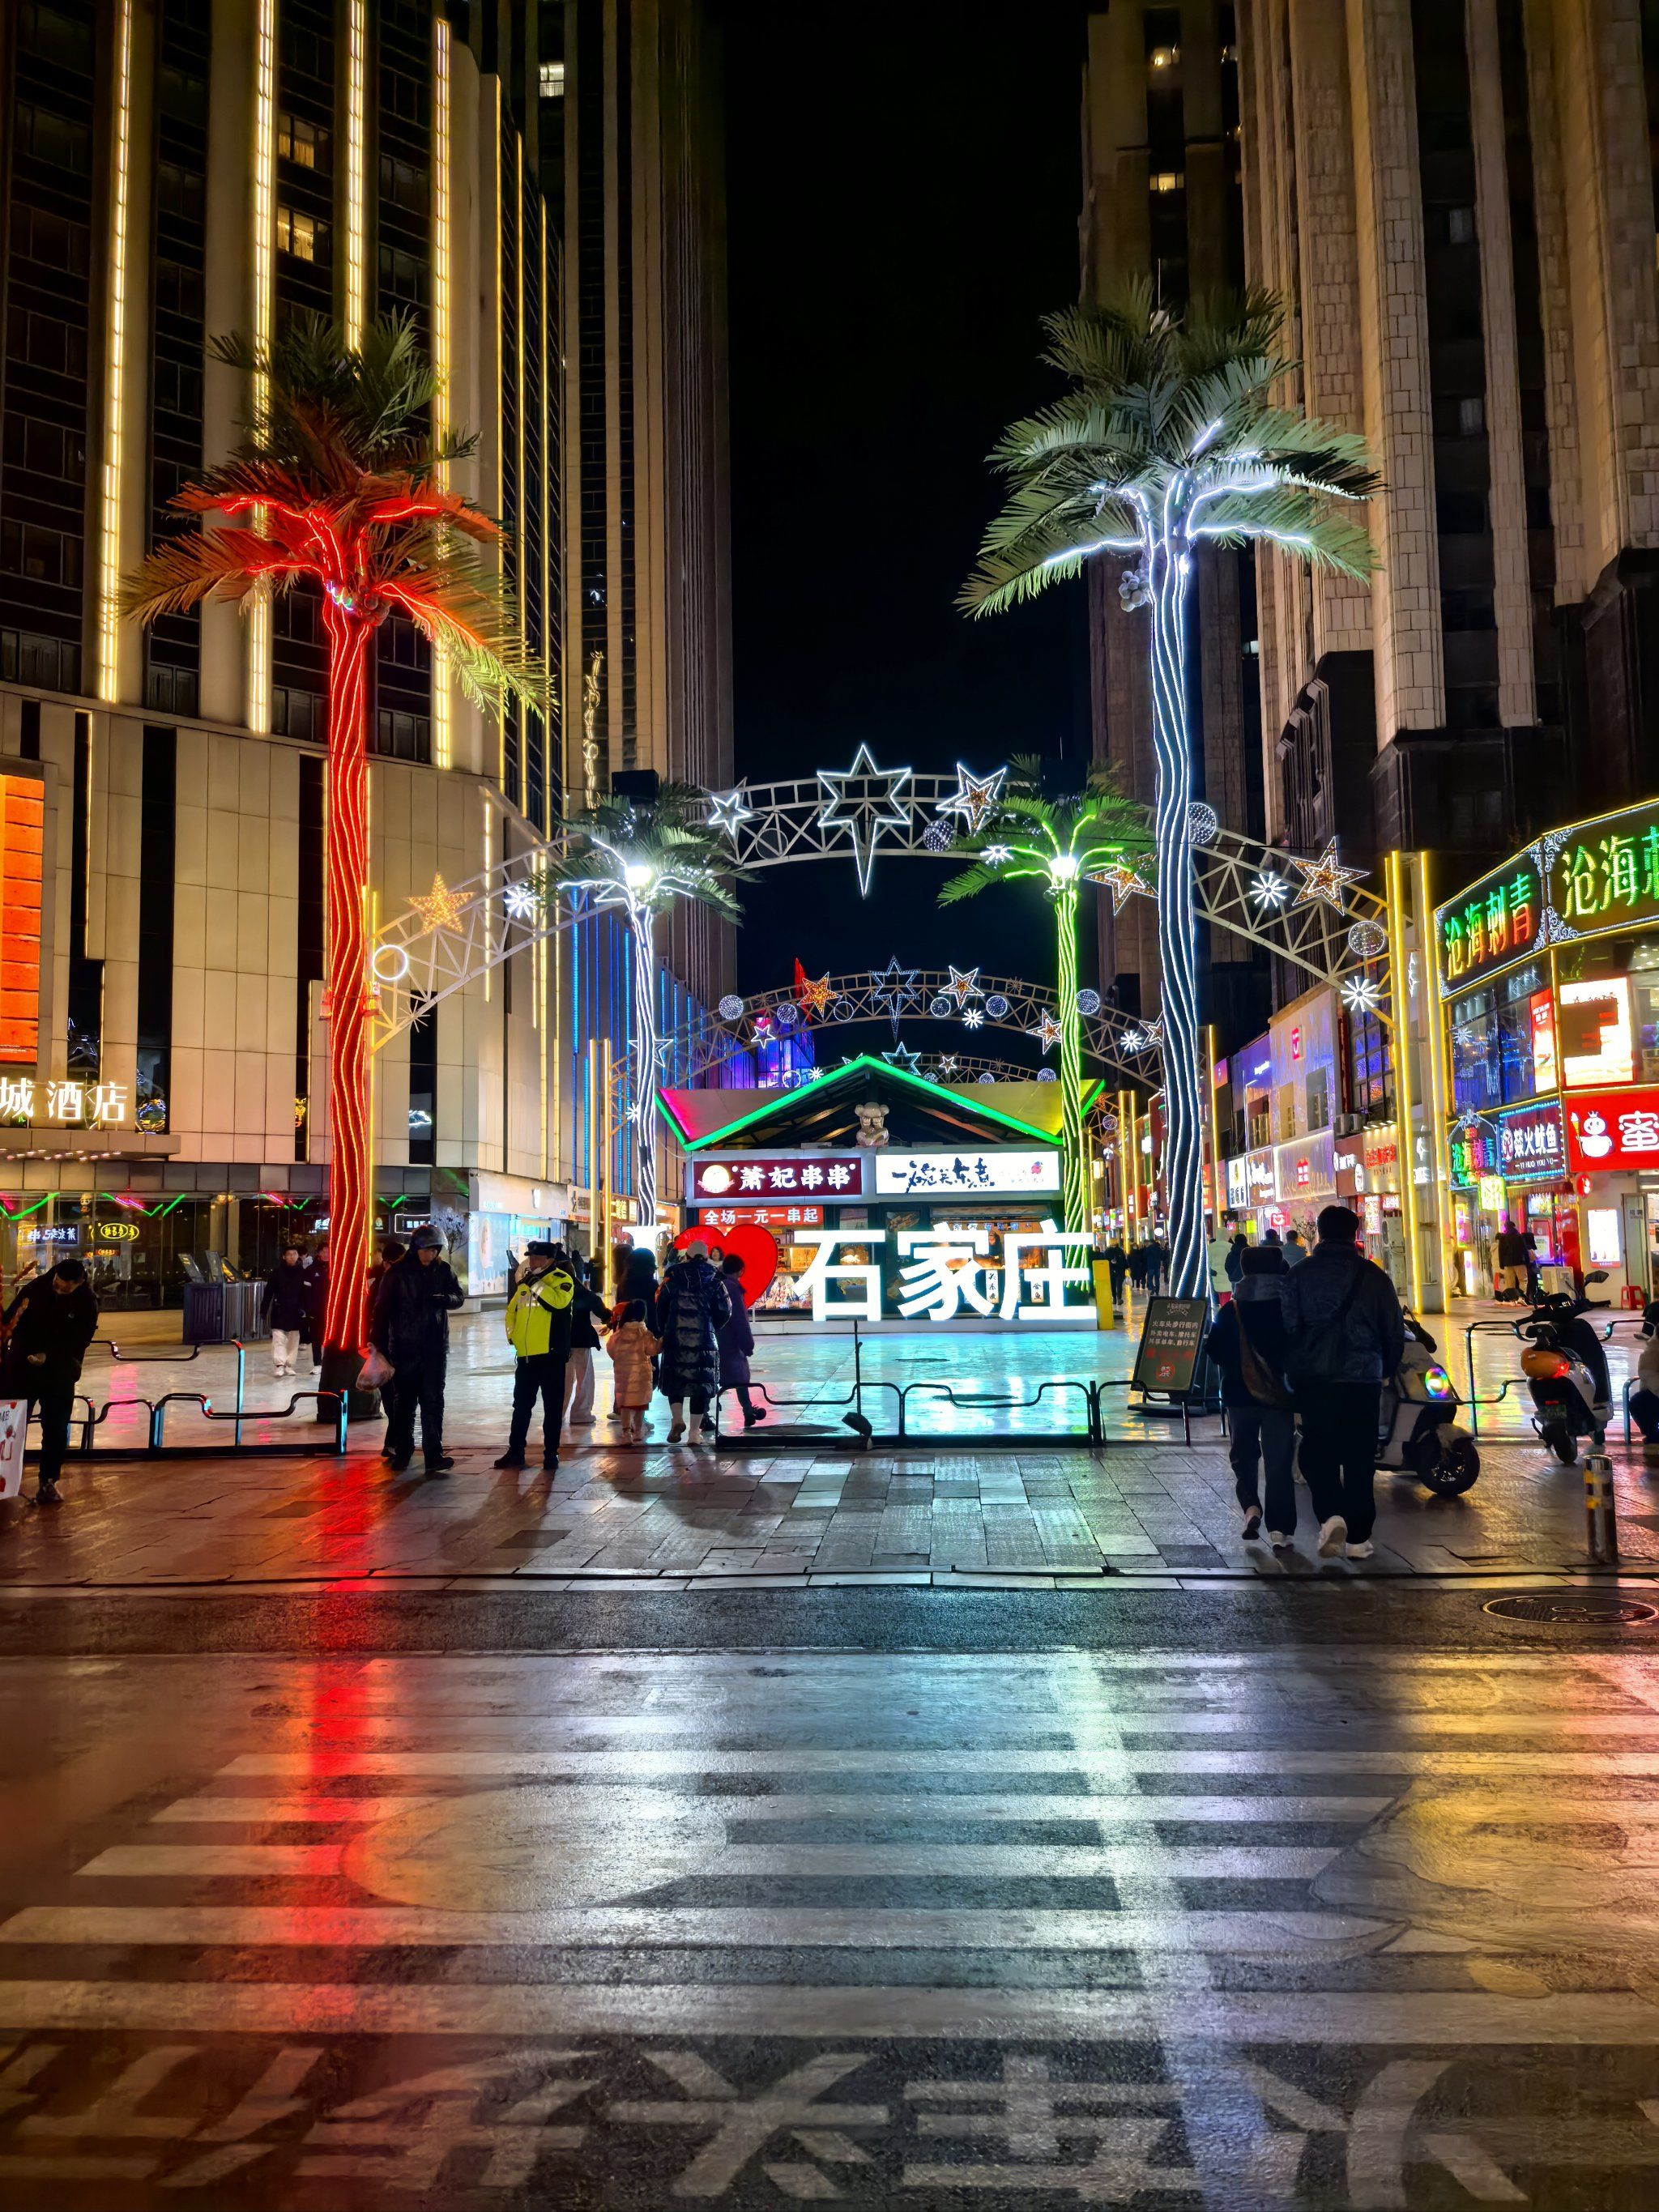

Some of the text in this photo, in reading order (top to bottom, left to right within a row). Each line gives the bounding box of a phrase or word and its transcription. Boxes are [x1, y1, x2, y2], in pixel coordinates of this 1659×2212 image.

[1445, 873, 1531, 981] 沧海刺青
[0, 1076, 128, 1122] 城酒店
[1618, 1110, 1659, 1152] 蜜
[739, 1164, 851, 1191] 萧妃串串
[704, 1208, 818, 1225] 全场一元一串起
[793, 1218, 1098, 1322] 石家庄
[1152, 1320, 1199, 1329] 火车头步行街内
[0, 2044, 1531, 2208] 火车头步行
